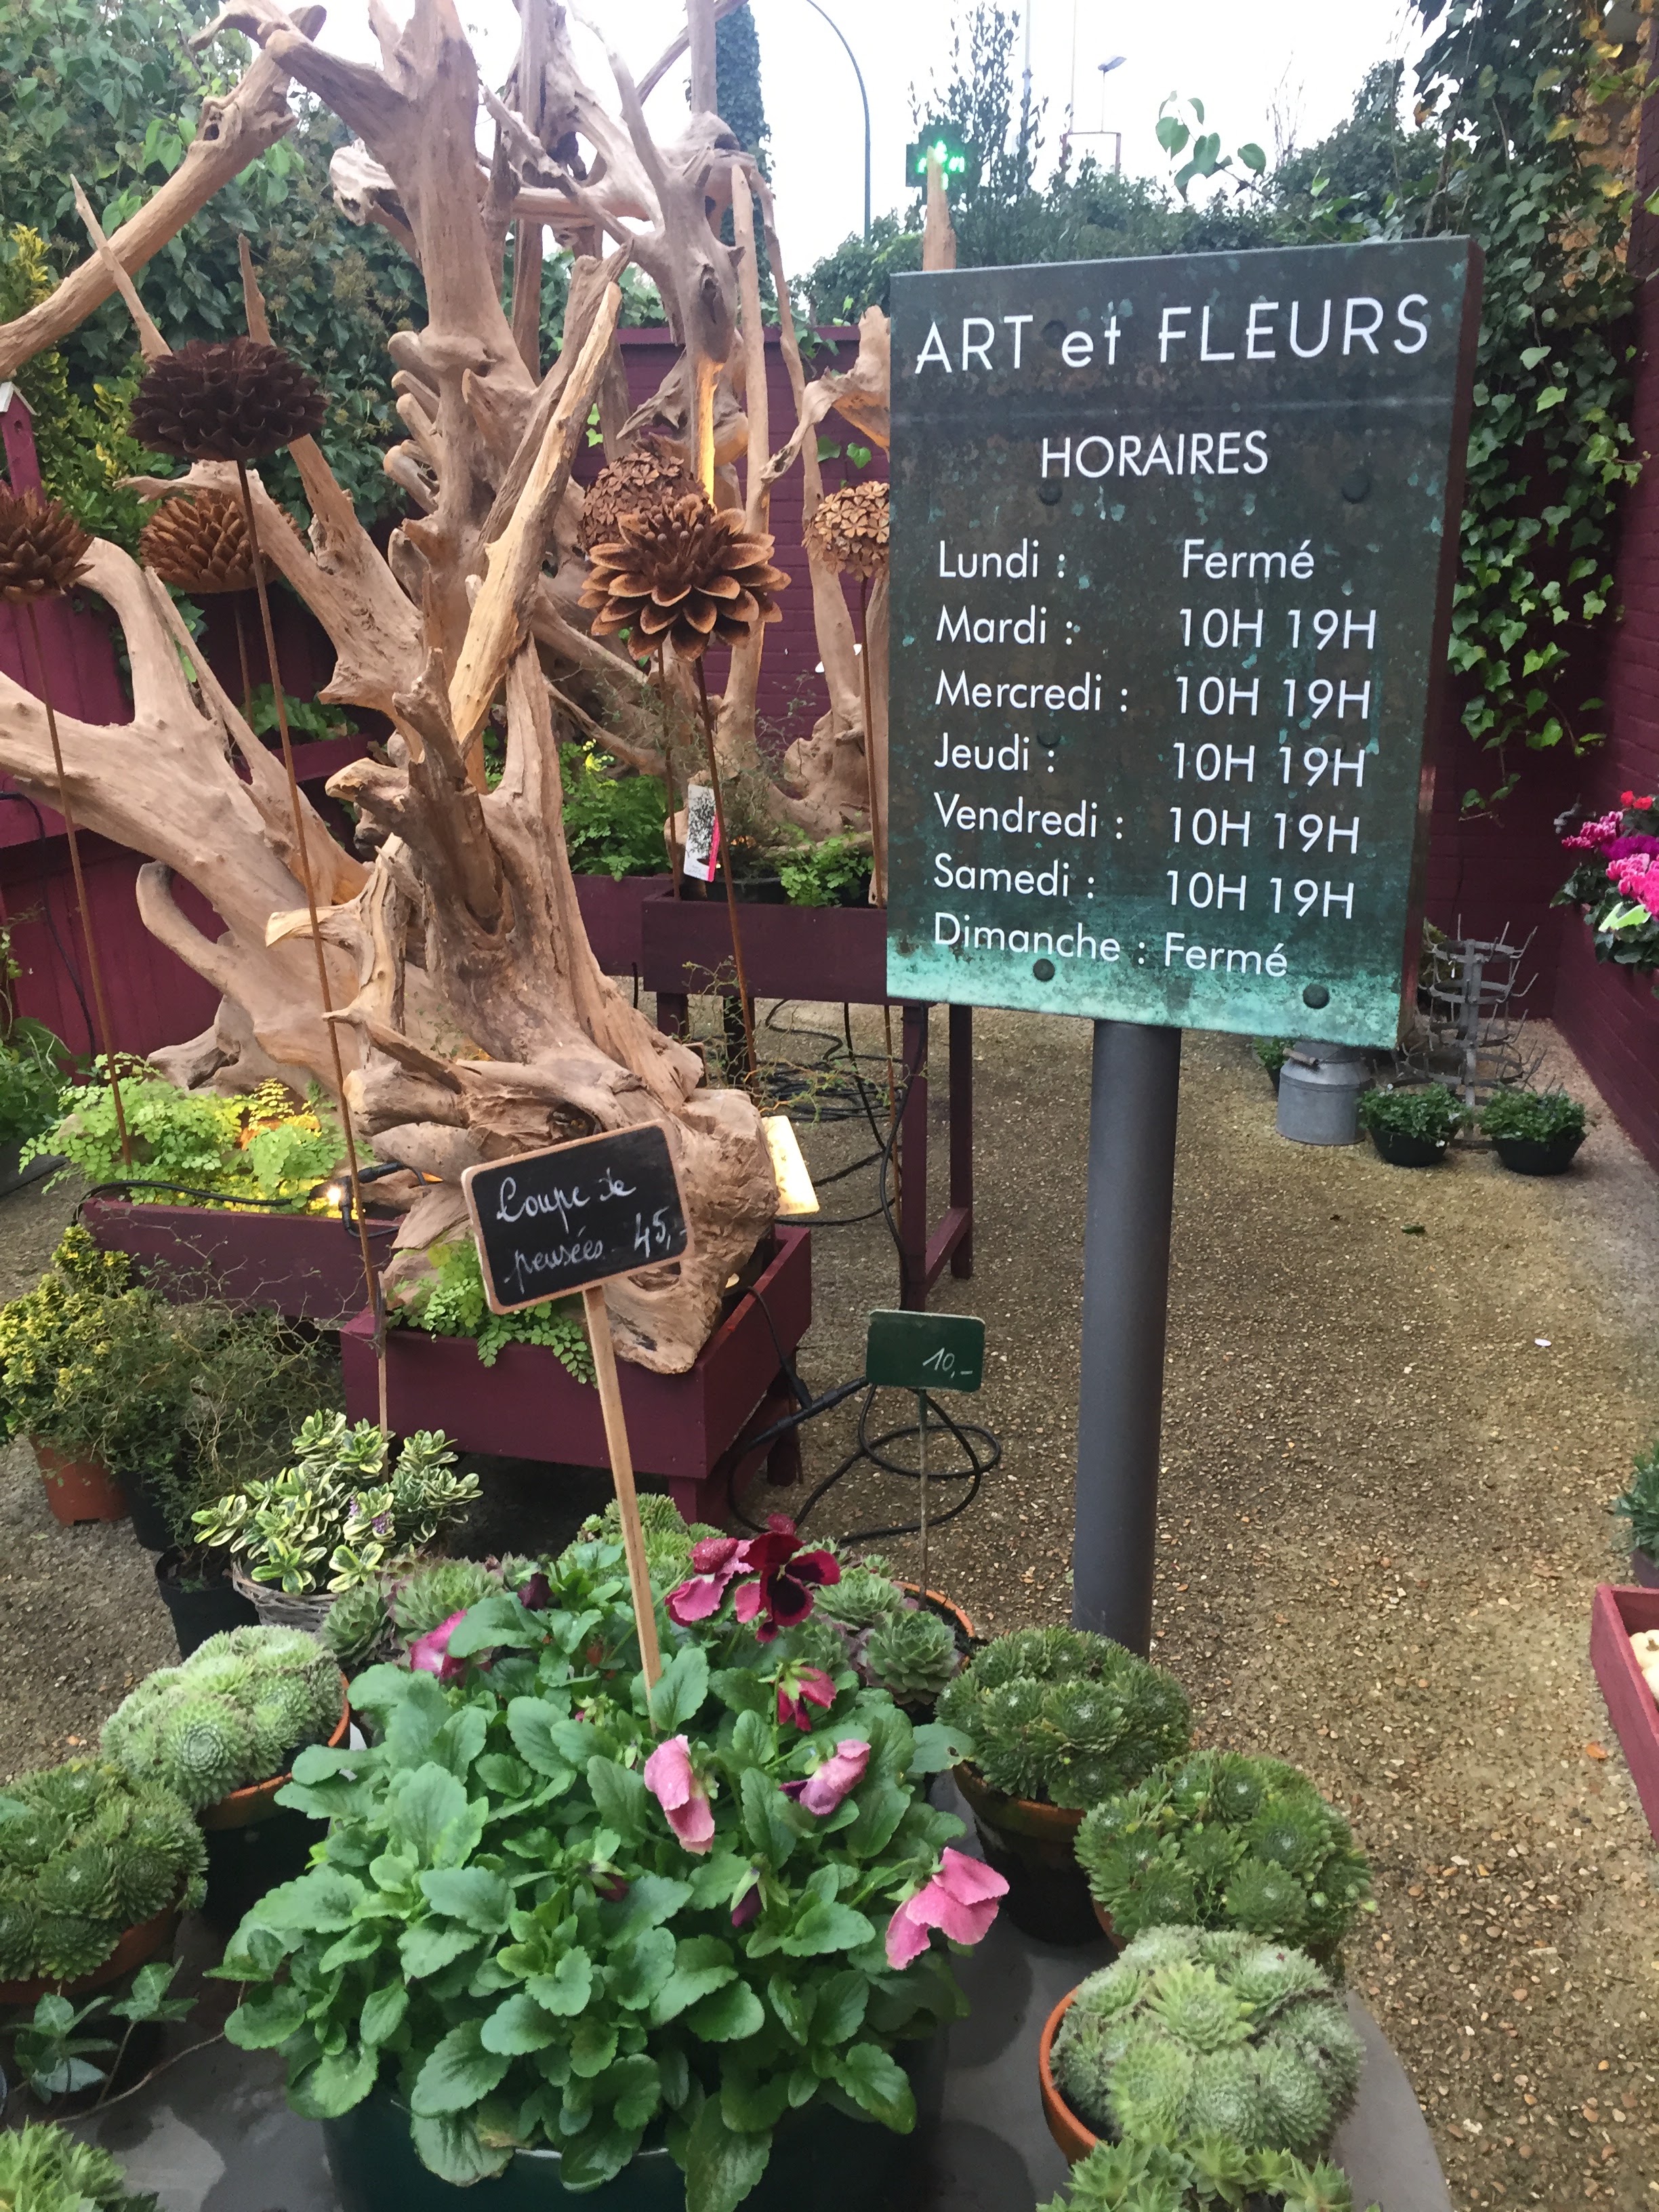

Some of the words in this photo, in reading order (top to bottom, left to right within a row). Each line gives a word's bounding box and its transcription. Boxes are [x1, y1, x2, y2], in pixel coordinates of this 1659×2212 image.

[914, 314, 1034, 375] ART
[1061, 314, 1122, 369] et
[1158, 293, 1429, 364] FLEURS
[1041, 429, 1269, 479] HORAIRES
[939, 537, 1040, 579] Lundi
[1182, 538, 1315, 579] Fermé
[935, 603, 1048, 645] Mardi
[1179, 607, 1265, 649] 10H
[1287, 609, 1377, 651] 19H
[934, 668, 1103, 712] Mercredi
[1175, 676, 1260, 716] 10H
[1282, 678, 1372, 720] 19H
[933, 731, 1030, 772] Jeudi
[1172, 741, 1256, 783] 10H
[1278, 745, 1366, 788] 19H
[933, 791, 1099, 838] Vendredi
[1169, 806, 1251, 848] 10H
[1273, 812, 1360, 855] 19H
[933, 852, 1070, 898] Samedi
[1166, 869, 1248, 912] 10H
[1269, 876, 1355, 920] 19H
[934, 911, 1122, 962] Dimanche
[1164, 931, 1288, 978] Fermé
[496, 1176, 591, 1234] Coupe
